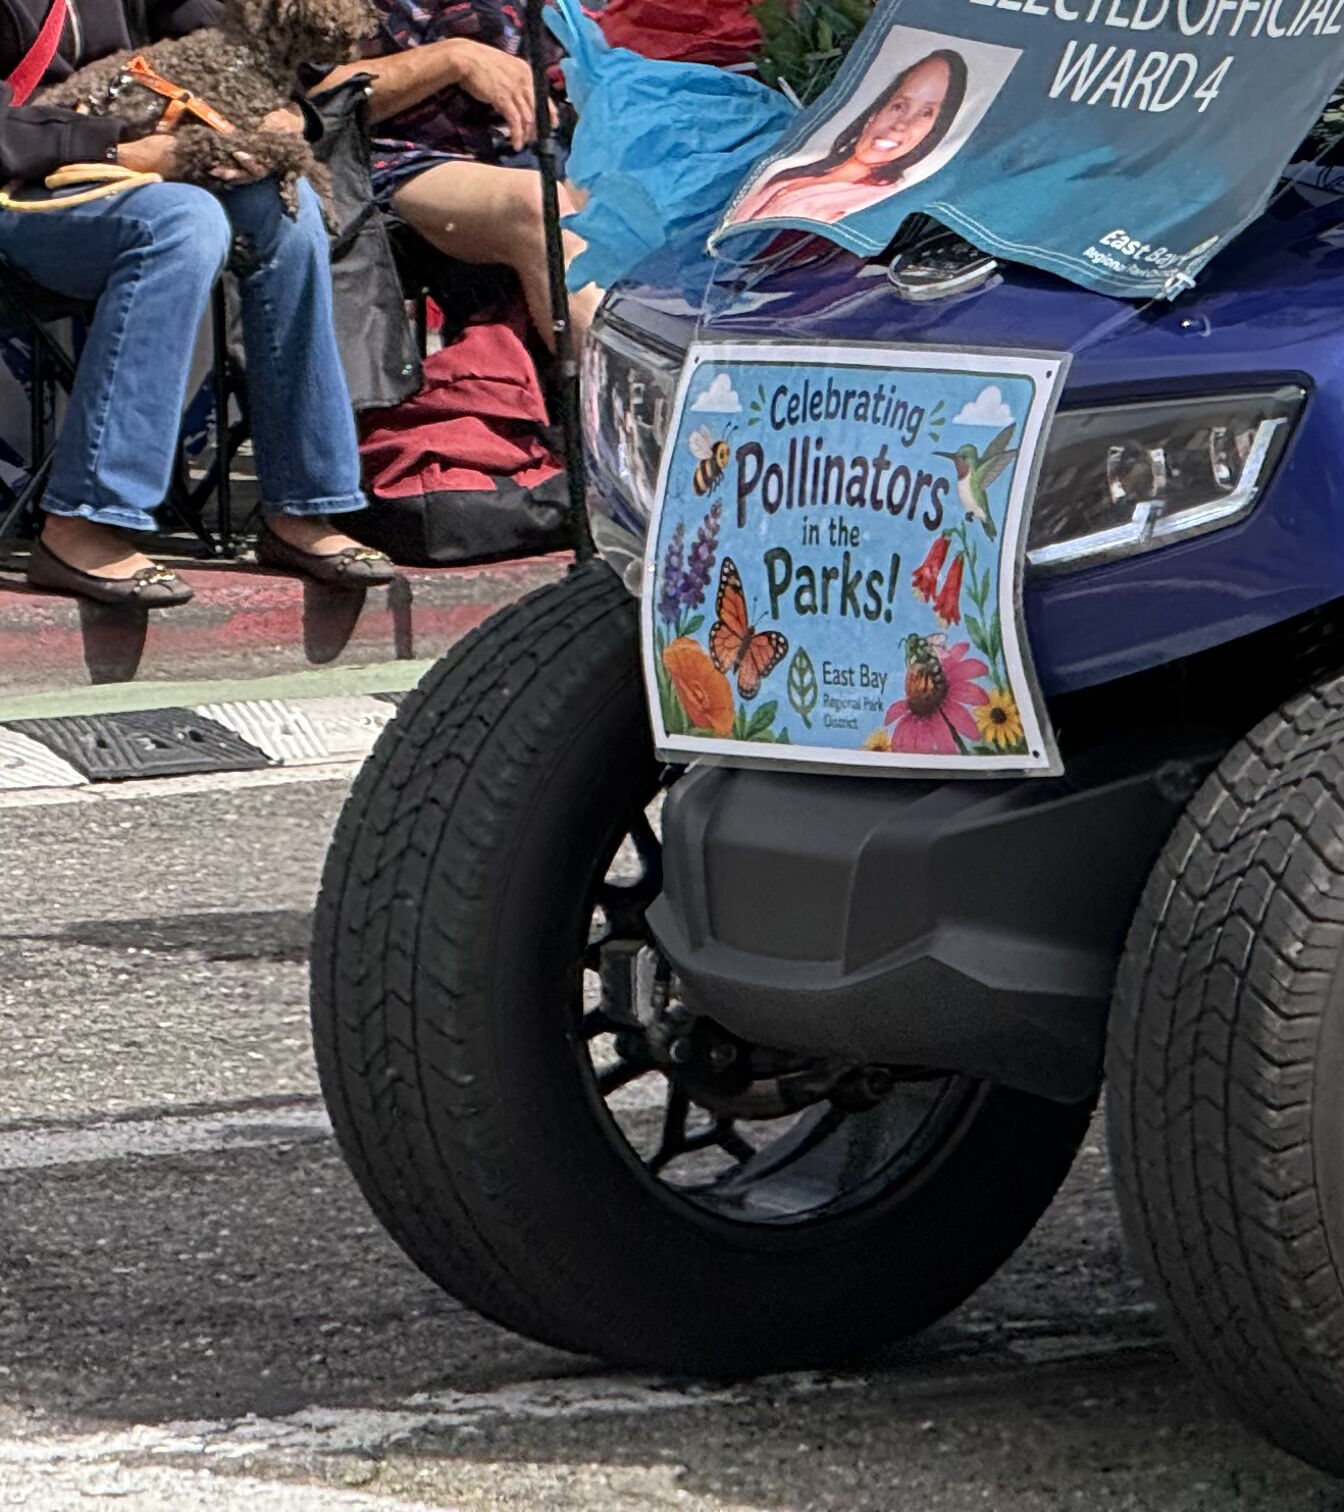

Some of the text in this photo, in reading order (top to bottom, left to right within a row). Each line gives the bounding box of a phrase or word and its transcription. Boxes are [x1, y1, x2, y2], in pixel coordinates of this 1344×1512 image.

[1049, 40, 1235, 113] WARD 4
[1100, 229, 1151, 260] East
[771, 377, 926, 448] Celebrating
[735, 438, 949, 532] Pollinators
[802, 516, 860, 548] in the
[764, 547, 901, 624] Parks!
[823, 661, 888, 695] East Bay
